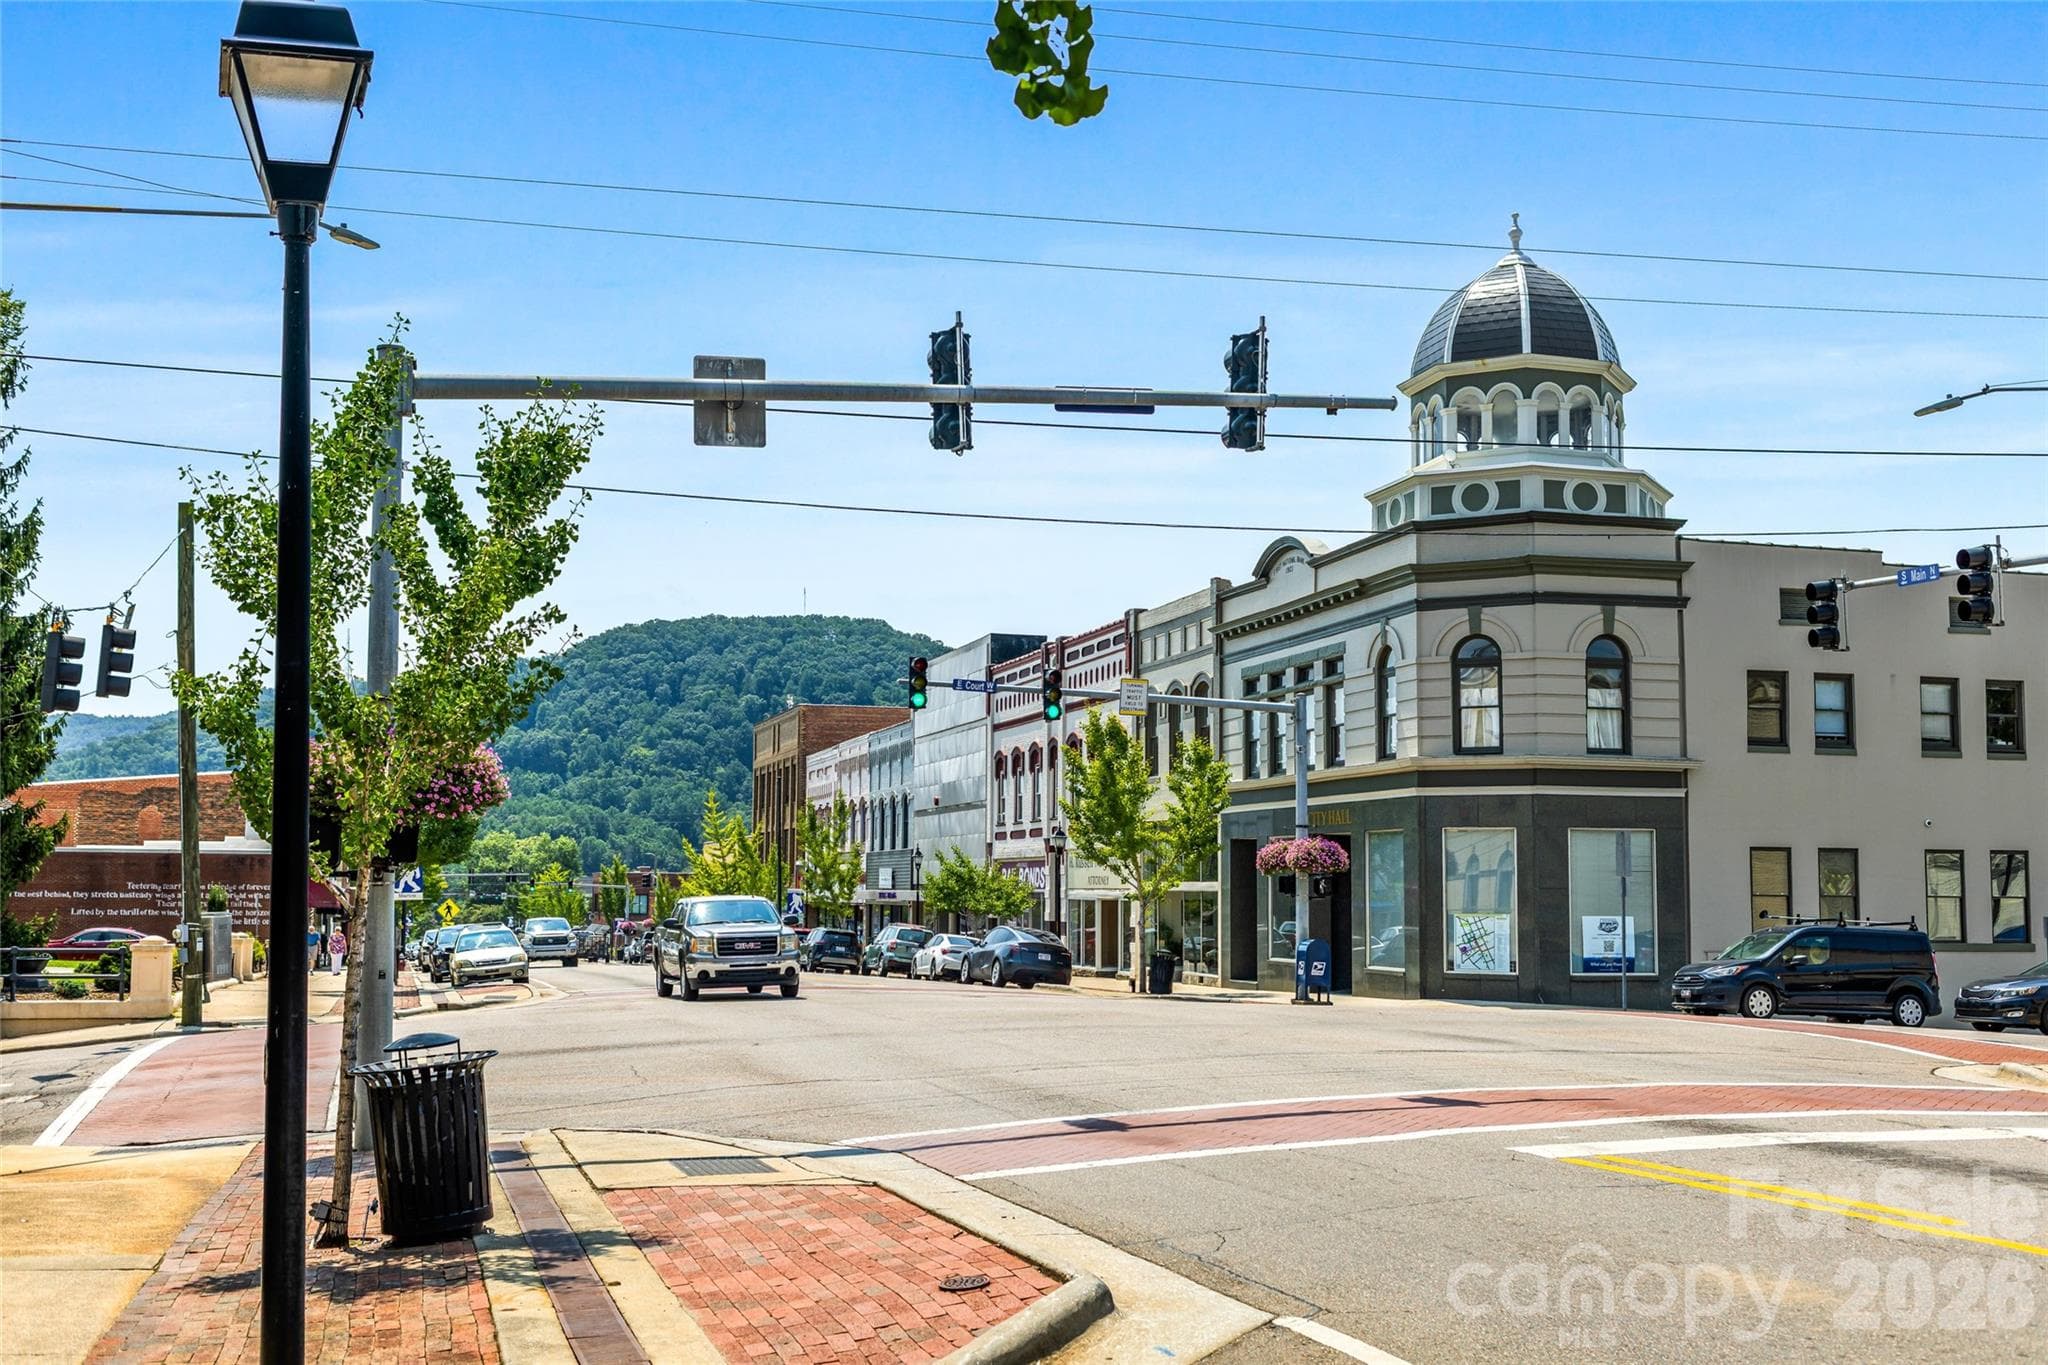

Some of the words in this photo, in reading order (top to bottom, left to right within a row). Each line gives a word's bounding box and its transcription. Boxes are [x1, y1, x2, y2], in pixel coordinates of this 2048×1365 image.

[1901, 570, 1906, 580] S
[1910, 569, 1926, 582] Main
[1930, 566, 1936, 576] N
[966, 681, 984, 690] Court
[1328, 806, 1352, 825] HALL
[1019, 867, 1044, 888] BONDS
[44, 890, 72, 898] behind,
[73, 890, 88, 899] they
[119, 891, 152, 900] unsteady
[155, 892, 175, 900] wings
[95, 908, 105, 917] by
